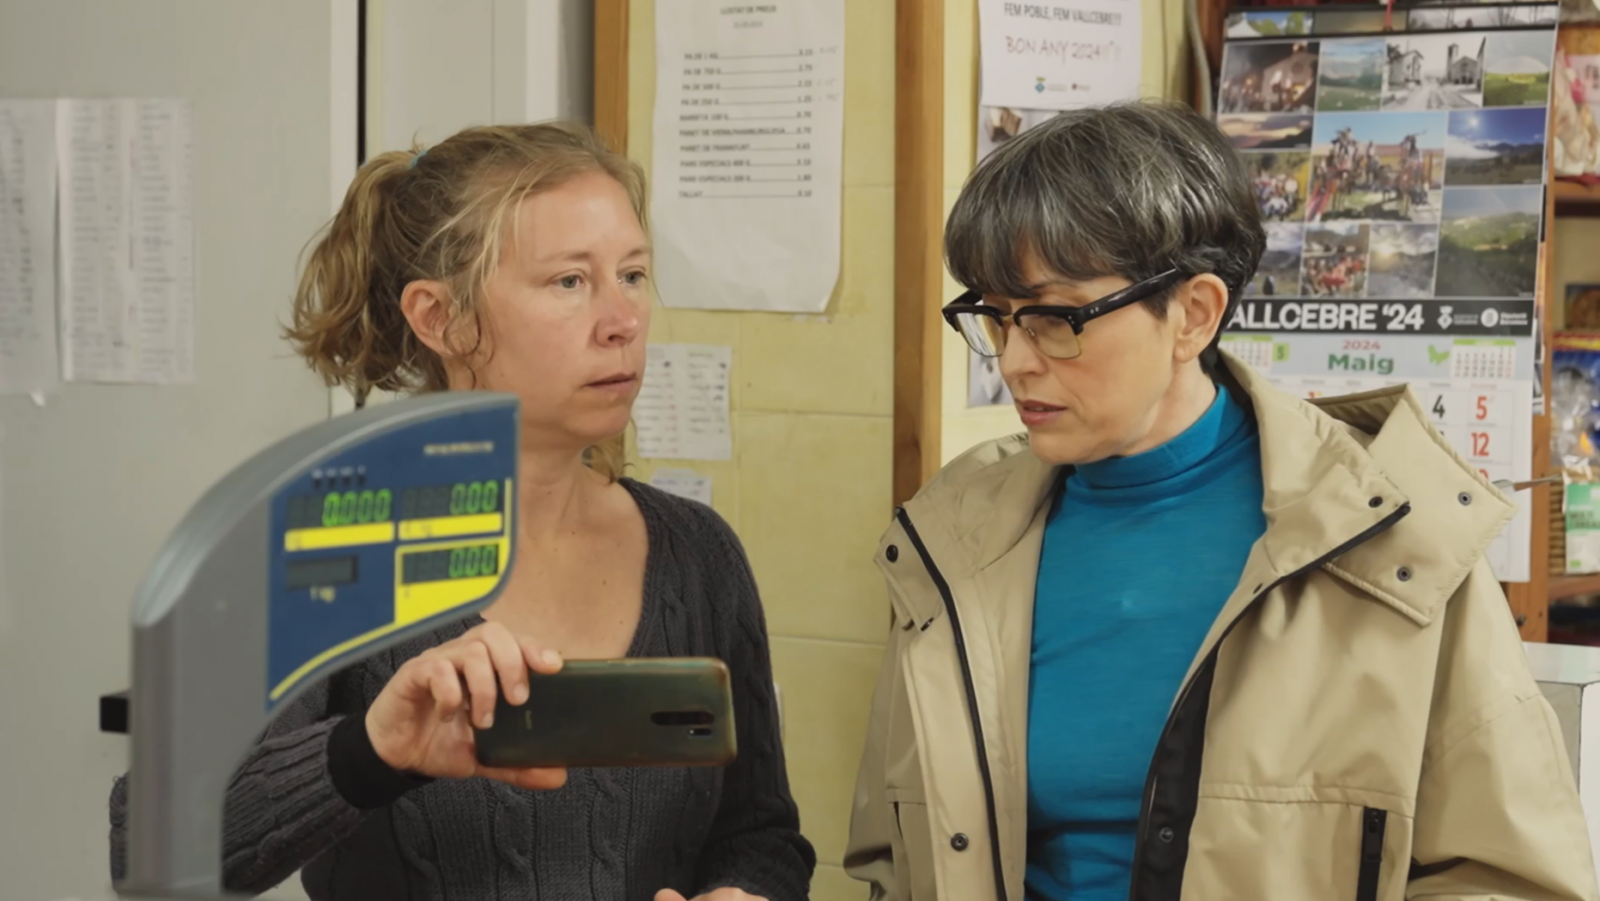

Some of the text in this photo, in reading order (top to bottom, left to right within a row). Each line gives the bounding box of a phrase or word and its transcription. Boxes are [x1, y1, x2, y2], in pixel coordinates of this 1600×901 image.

[1004, 3, 1021, 16] FEM
[1053, 7, 1070, 20] FEM
[1006, 36, 1036, 54] BON
[1038, 39, 1069, 65] ANY
[1227, 303, 1377, 330] ALLCEBRE
[1277, 345, 1285, 360] 5
[1342, 340, 1381, 350] 2024
[1327, 353, 1395, 375] Maig
[1432, 395, 1488, 420] 4 5
[1472, 432, 1490, 457] 12
